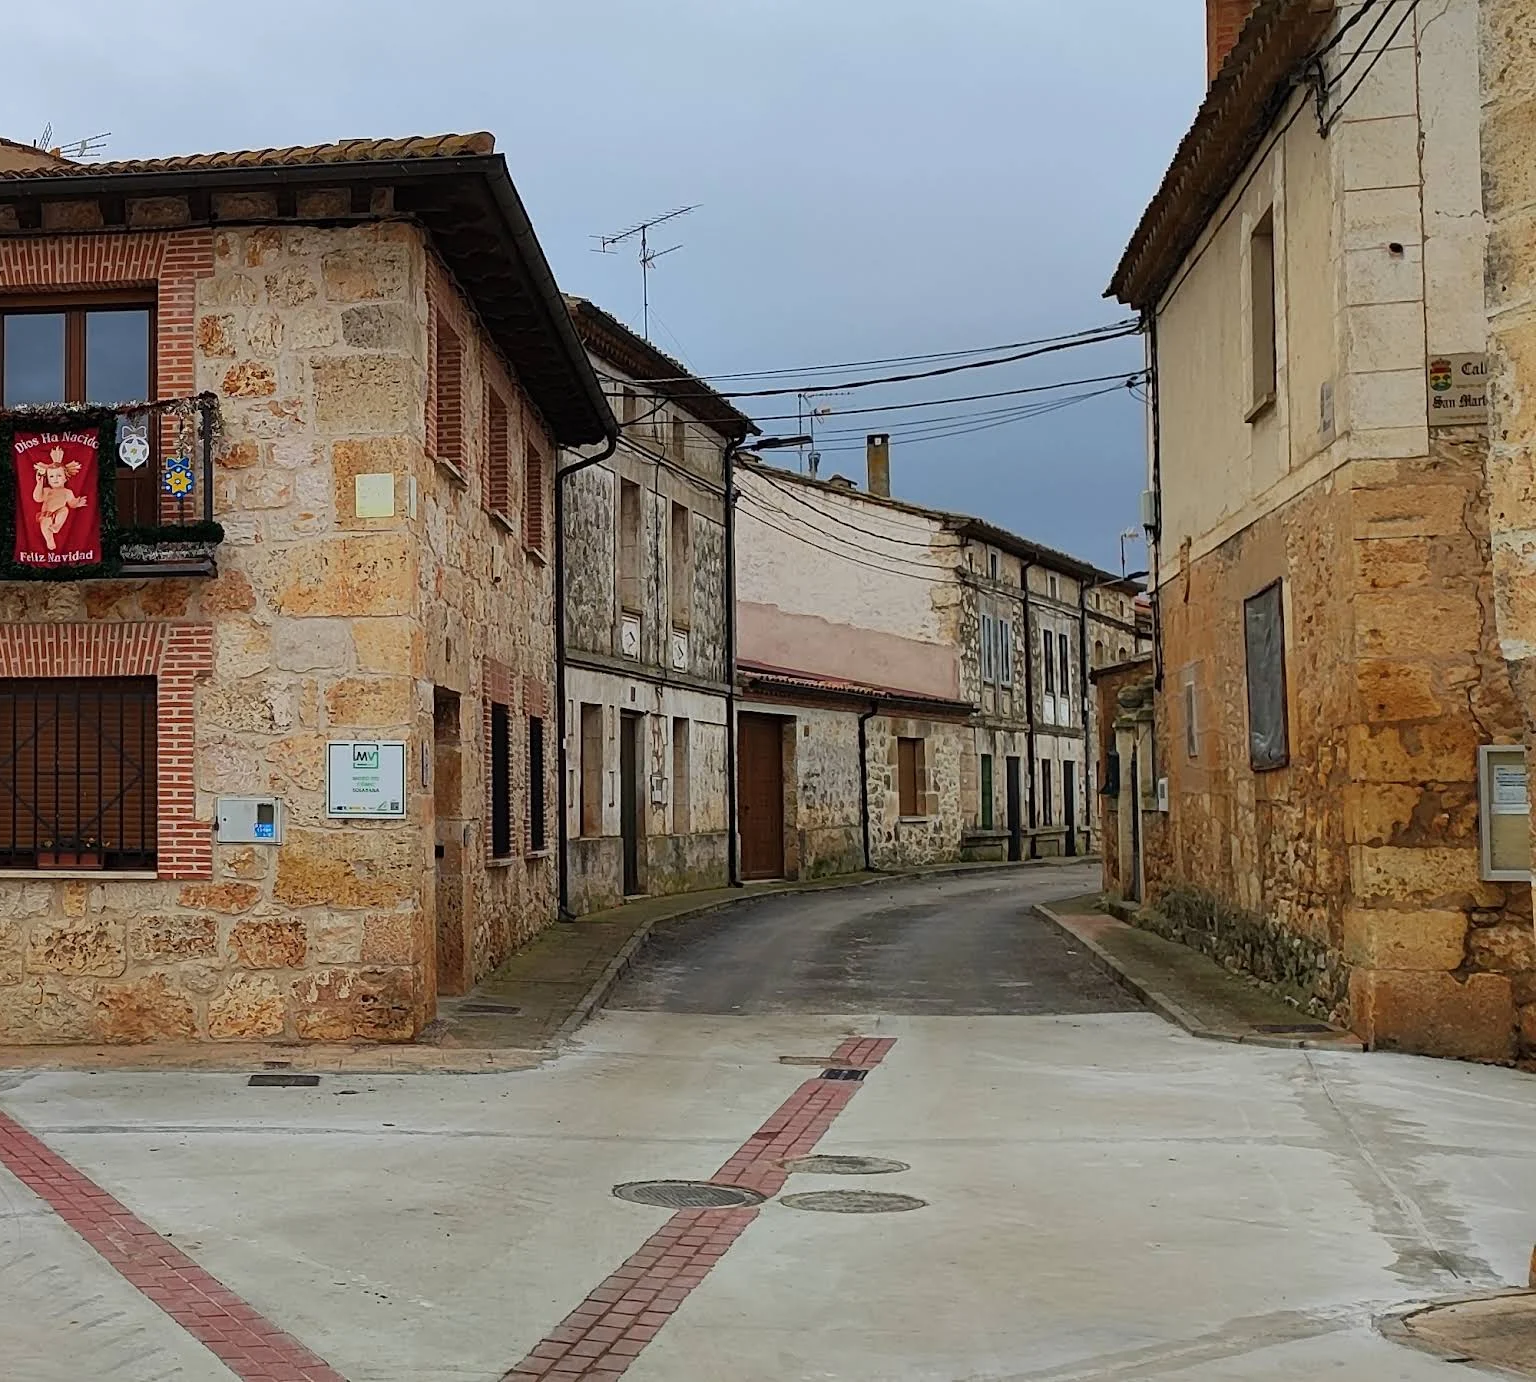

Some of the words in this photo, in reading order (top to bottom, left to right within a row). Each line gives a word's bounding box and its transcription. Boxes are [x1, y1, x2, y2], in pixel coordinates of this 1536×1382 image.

[1432, 395, 1456, 409] San
[14, 437, 39, 454] Dios
[40, 432, 59, 444] Ha
[20, 551, 46, 562] Feliz
[47, 550, 94, 563] Navidad
[356, 751, 377, 762] MV
